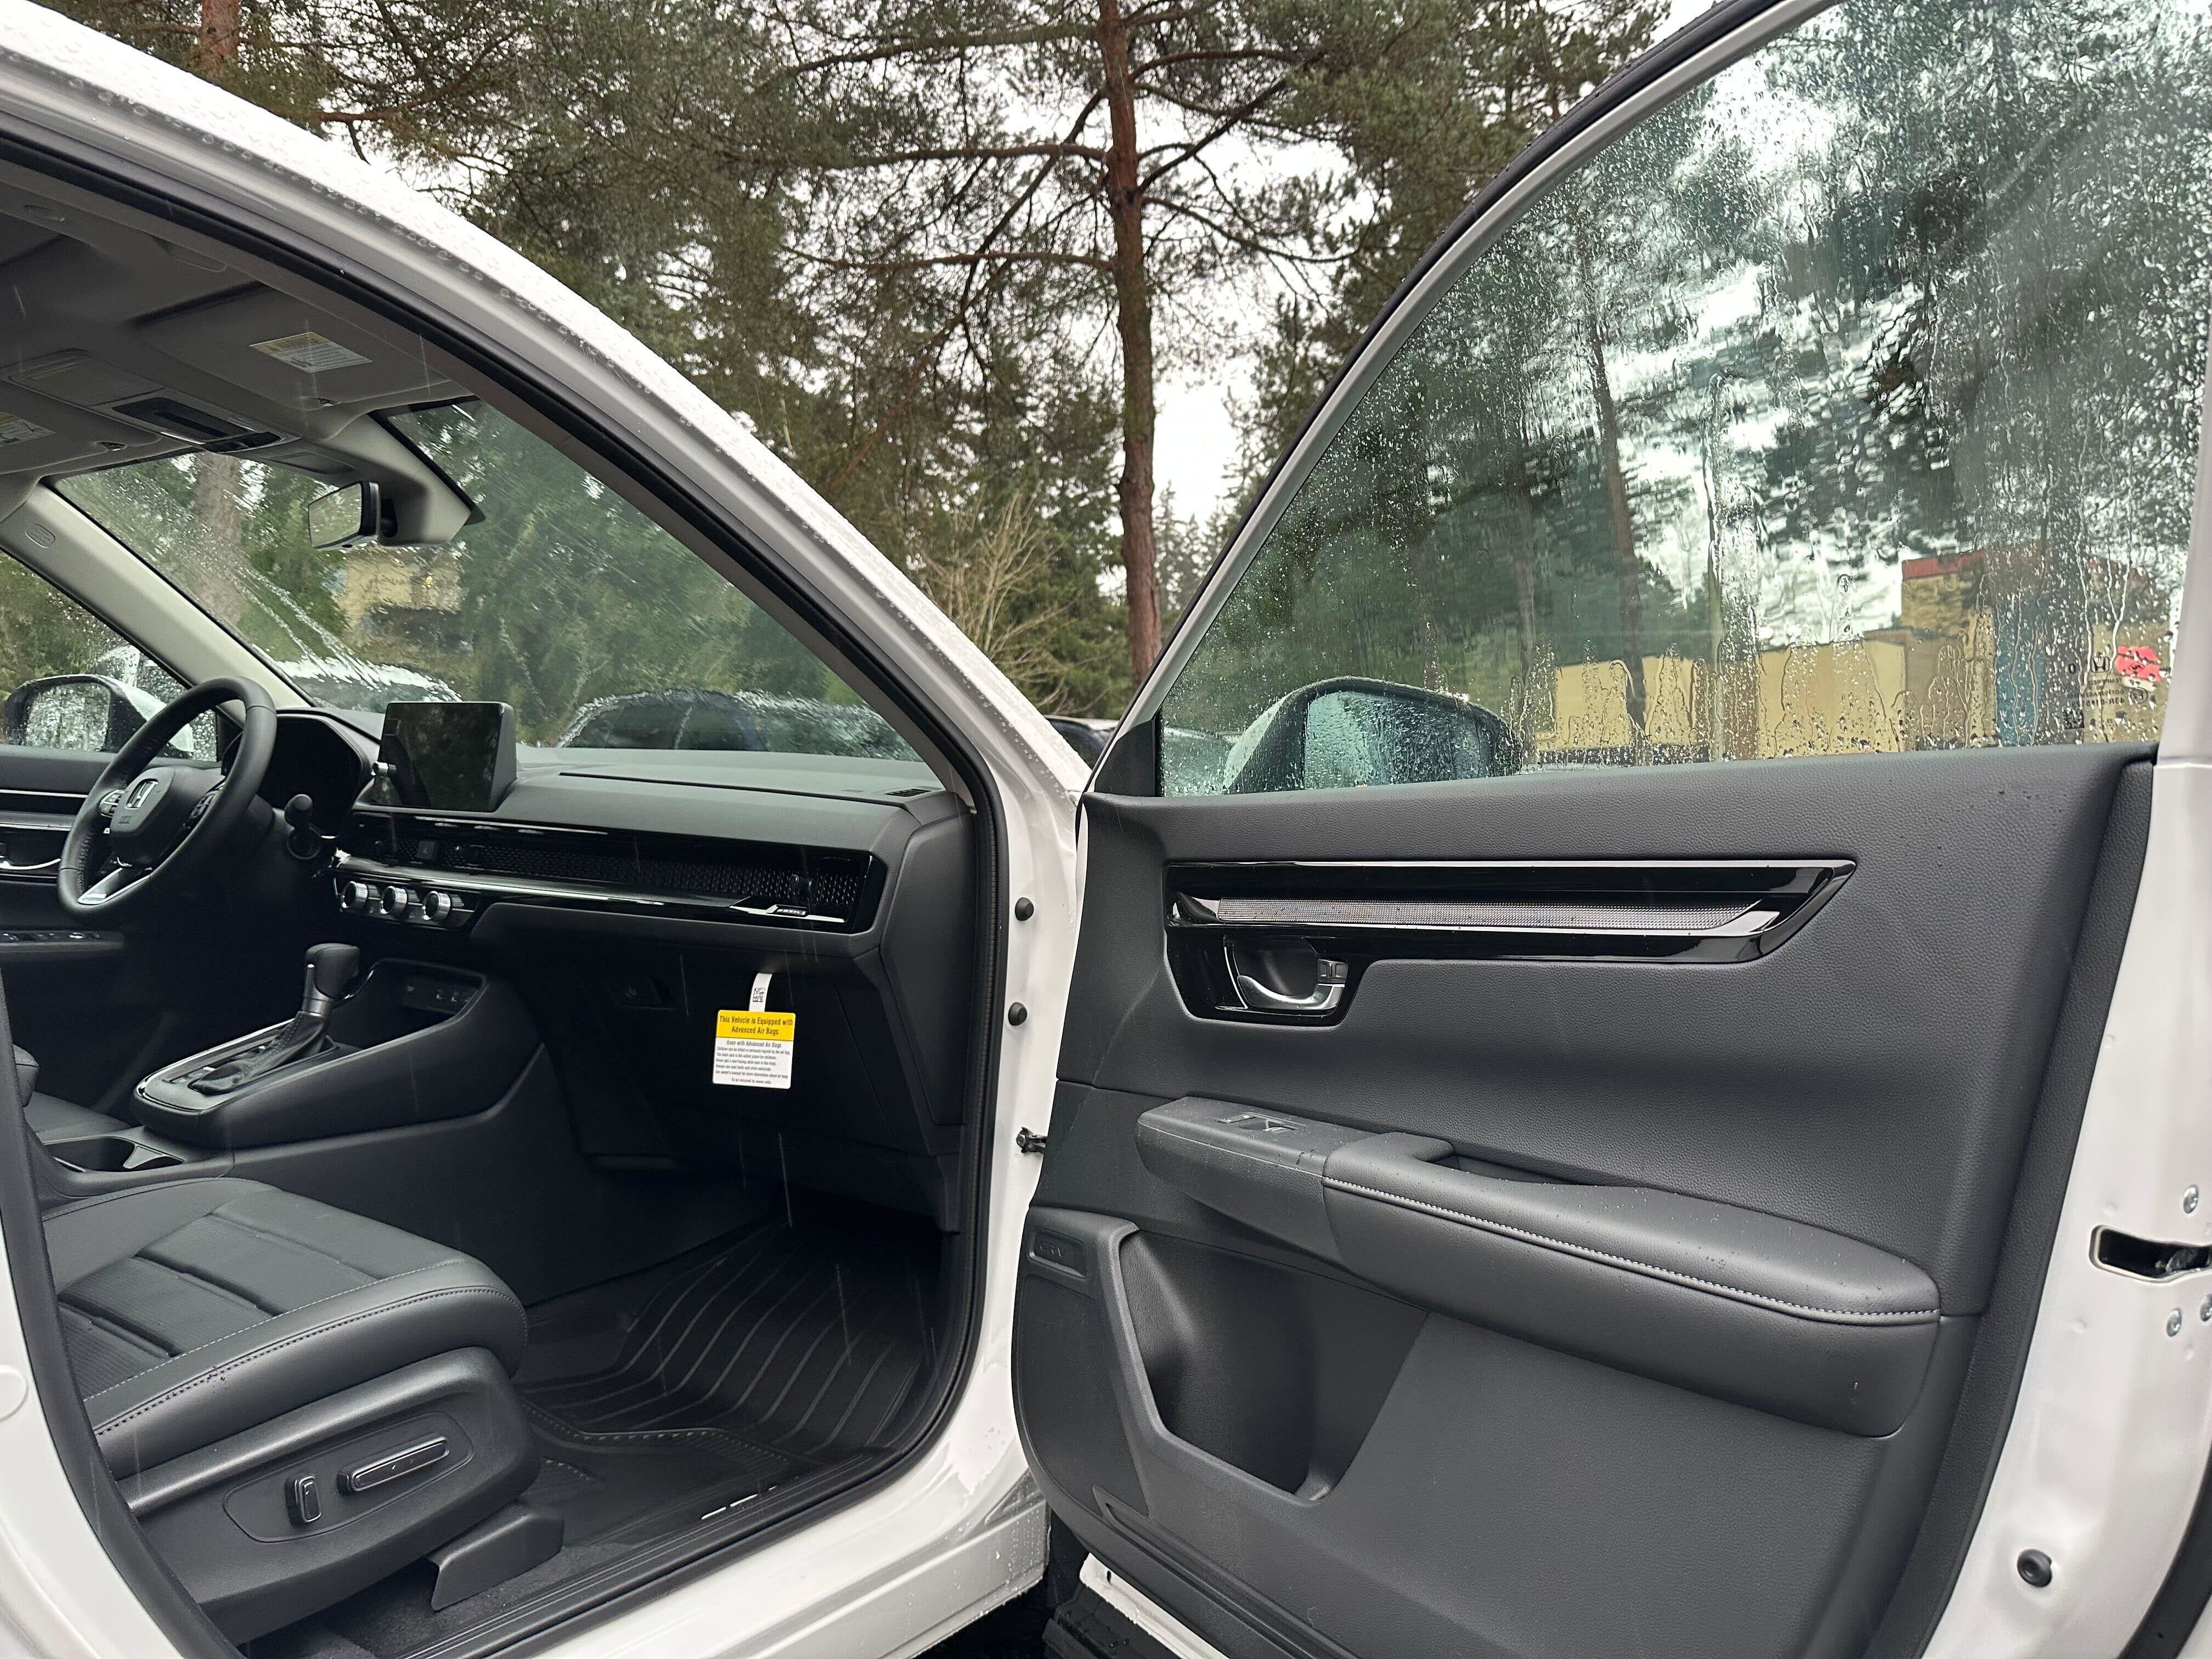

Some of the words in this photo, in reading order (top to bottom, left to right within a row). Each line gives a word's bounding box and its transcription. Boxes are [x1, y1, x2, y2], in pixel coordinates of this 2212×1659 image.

[731, 1016, 750, 1024] Vehicle
[757, 1017, 781, 1026] Equipped
[766, 1028, 779, 1036] Bags
